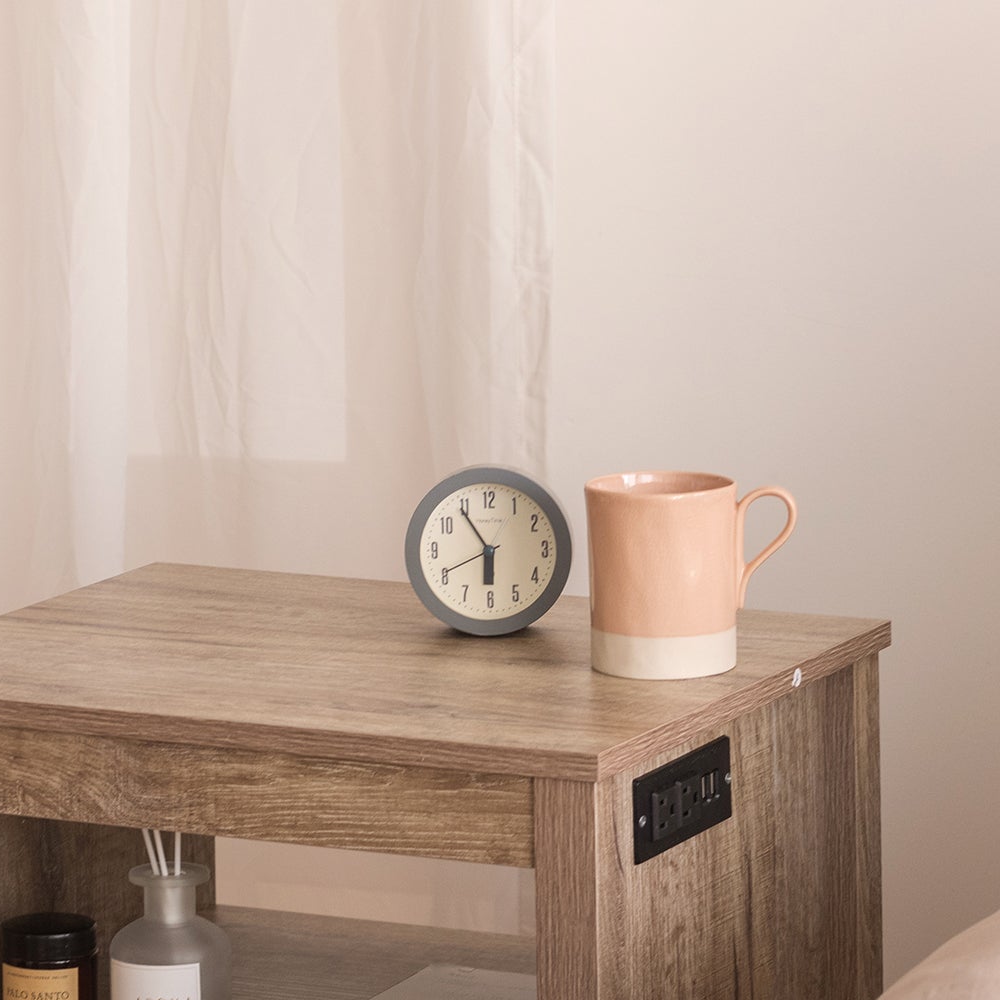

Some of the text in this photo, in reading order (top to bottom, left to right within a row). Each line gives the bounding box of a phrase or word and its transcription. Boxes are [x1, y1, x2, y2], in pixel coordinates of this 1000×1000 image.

[460, 498, 469, 516] 11
[483, 491, 495, 509] 12
[512, 497, 516, 515] 1
[440, 516, 453, 534] 10
[531, 514, 538, 532] 2
[431, 542, 438, 559] 9
[541, 540, 549, 558] 3
[441, 567, 448, 585] 8
[531, 566, 539, 584] 4
[462, 585, 469, 602] 7
[487, 590, 494, 608] 6
[512, 584, 519, 602] 5
[6, 987, 70, 1000] PALO SANTO
